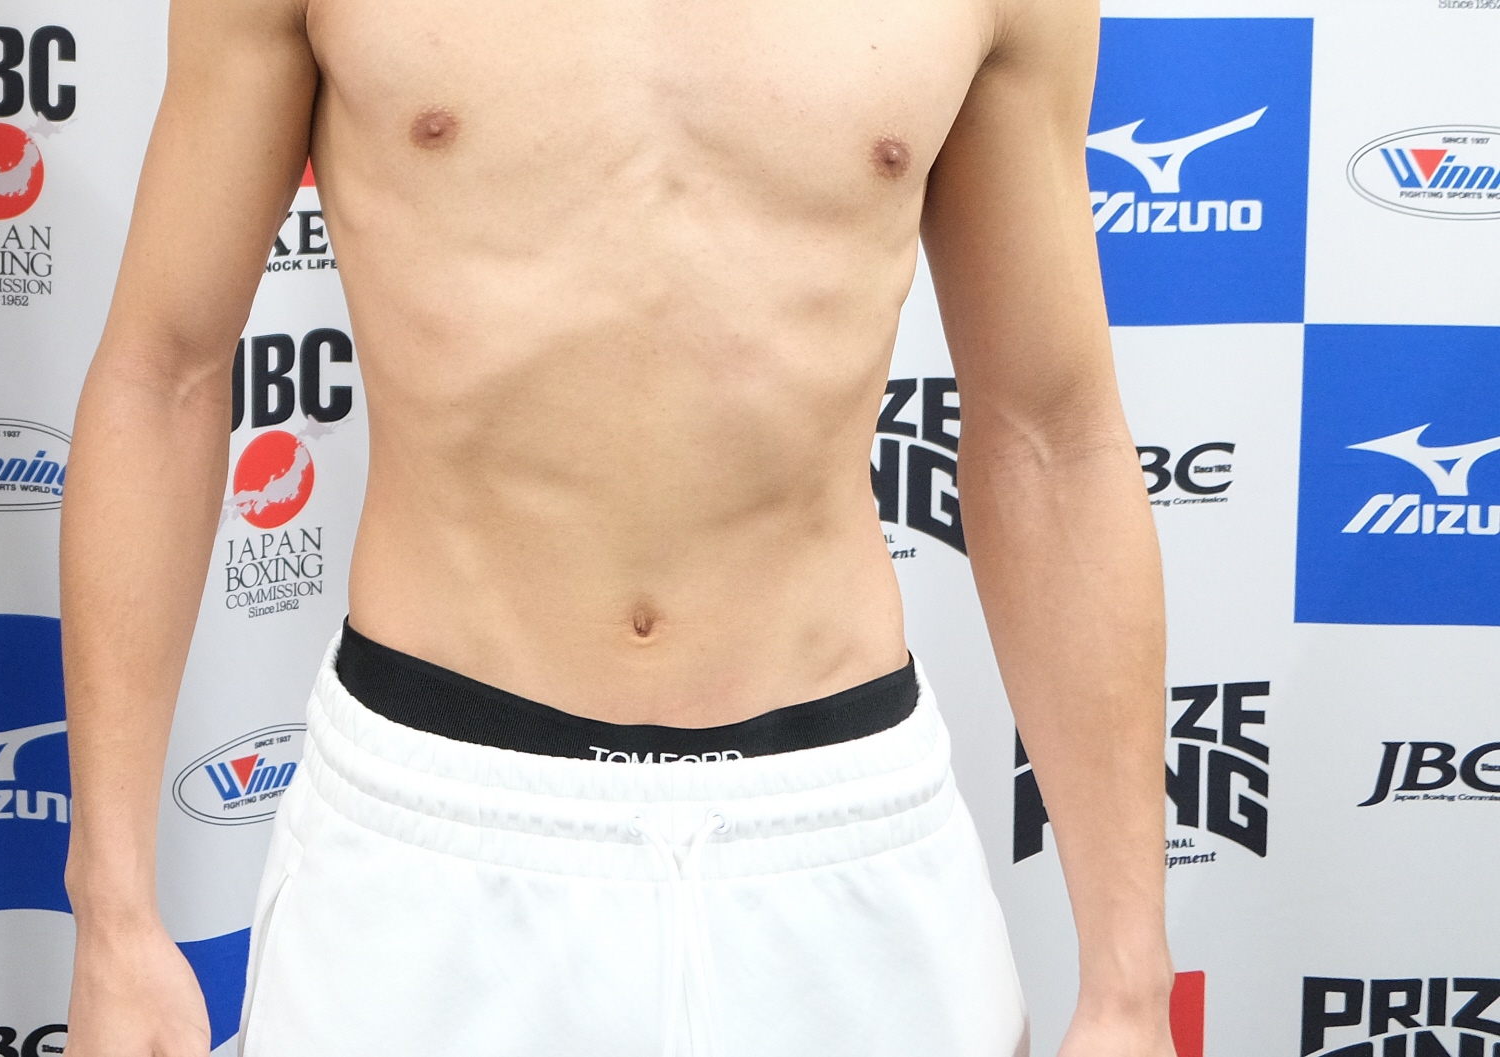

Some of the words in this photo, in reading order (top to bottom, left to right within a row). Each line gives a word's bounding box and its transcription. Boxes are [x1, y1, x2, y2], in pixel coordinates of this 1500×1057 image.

[1400, 191, 1443, 199] FIGHTING
[1446, 191, 1482, 200] SPORTS
[2, 294, 29, 307] 1952
[3, 430, 21, 438] 1937
[20, 485, 50, 493] WORLD
[1173, 497, 1228, 505] Commission
[1342, 493, 1500, 536] MIZU
[226, 527, 323, 566] JAPAN
[225, 554, 323, 593] BOXING
[226, 581, 323, 610] COMMISSION
[248, 605, 275, 619] Since
[275, 598, 299, 613] 1952
[254, 739, 274, 749] SINCE
[276, 735, 291, 744] 1937
[204, 753, 298, 801] Winn
[223, 796, 257, 811] FIGHTING
[1393, 793, 1420, 803] Japan
[1302, 976, 1500, 1057] PRIZ
